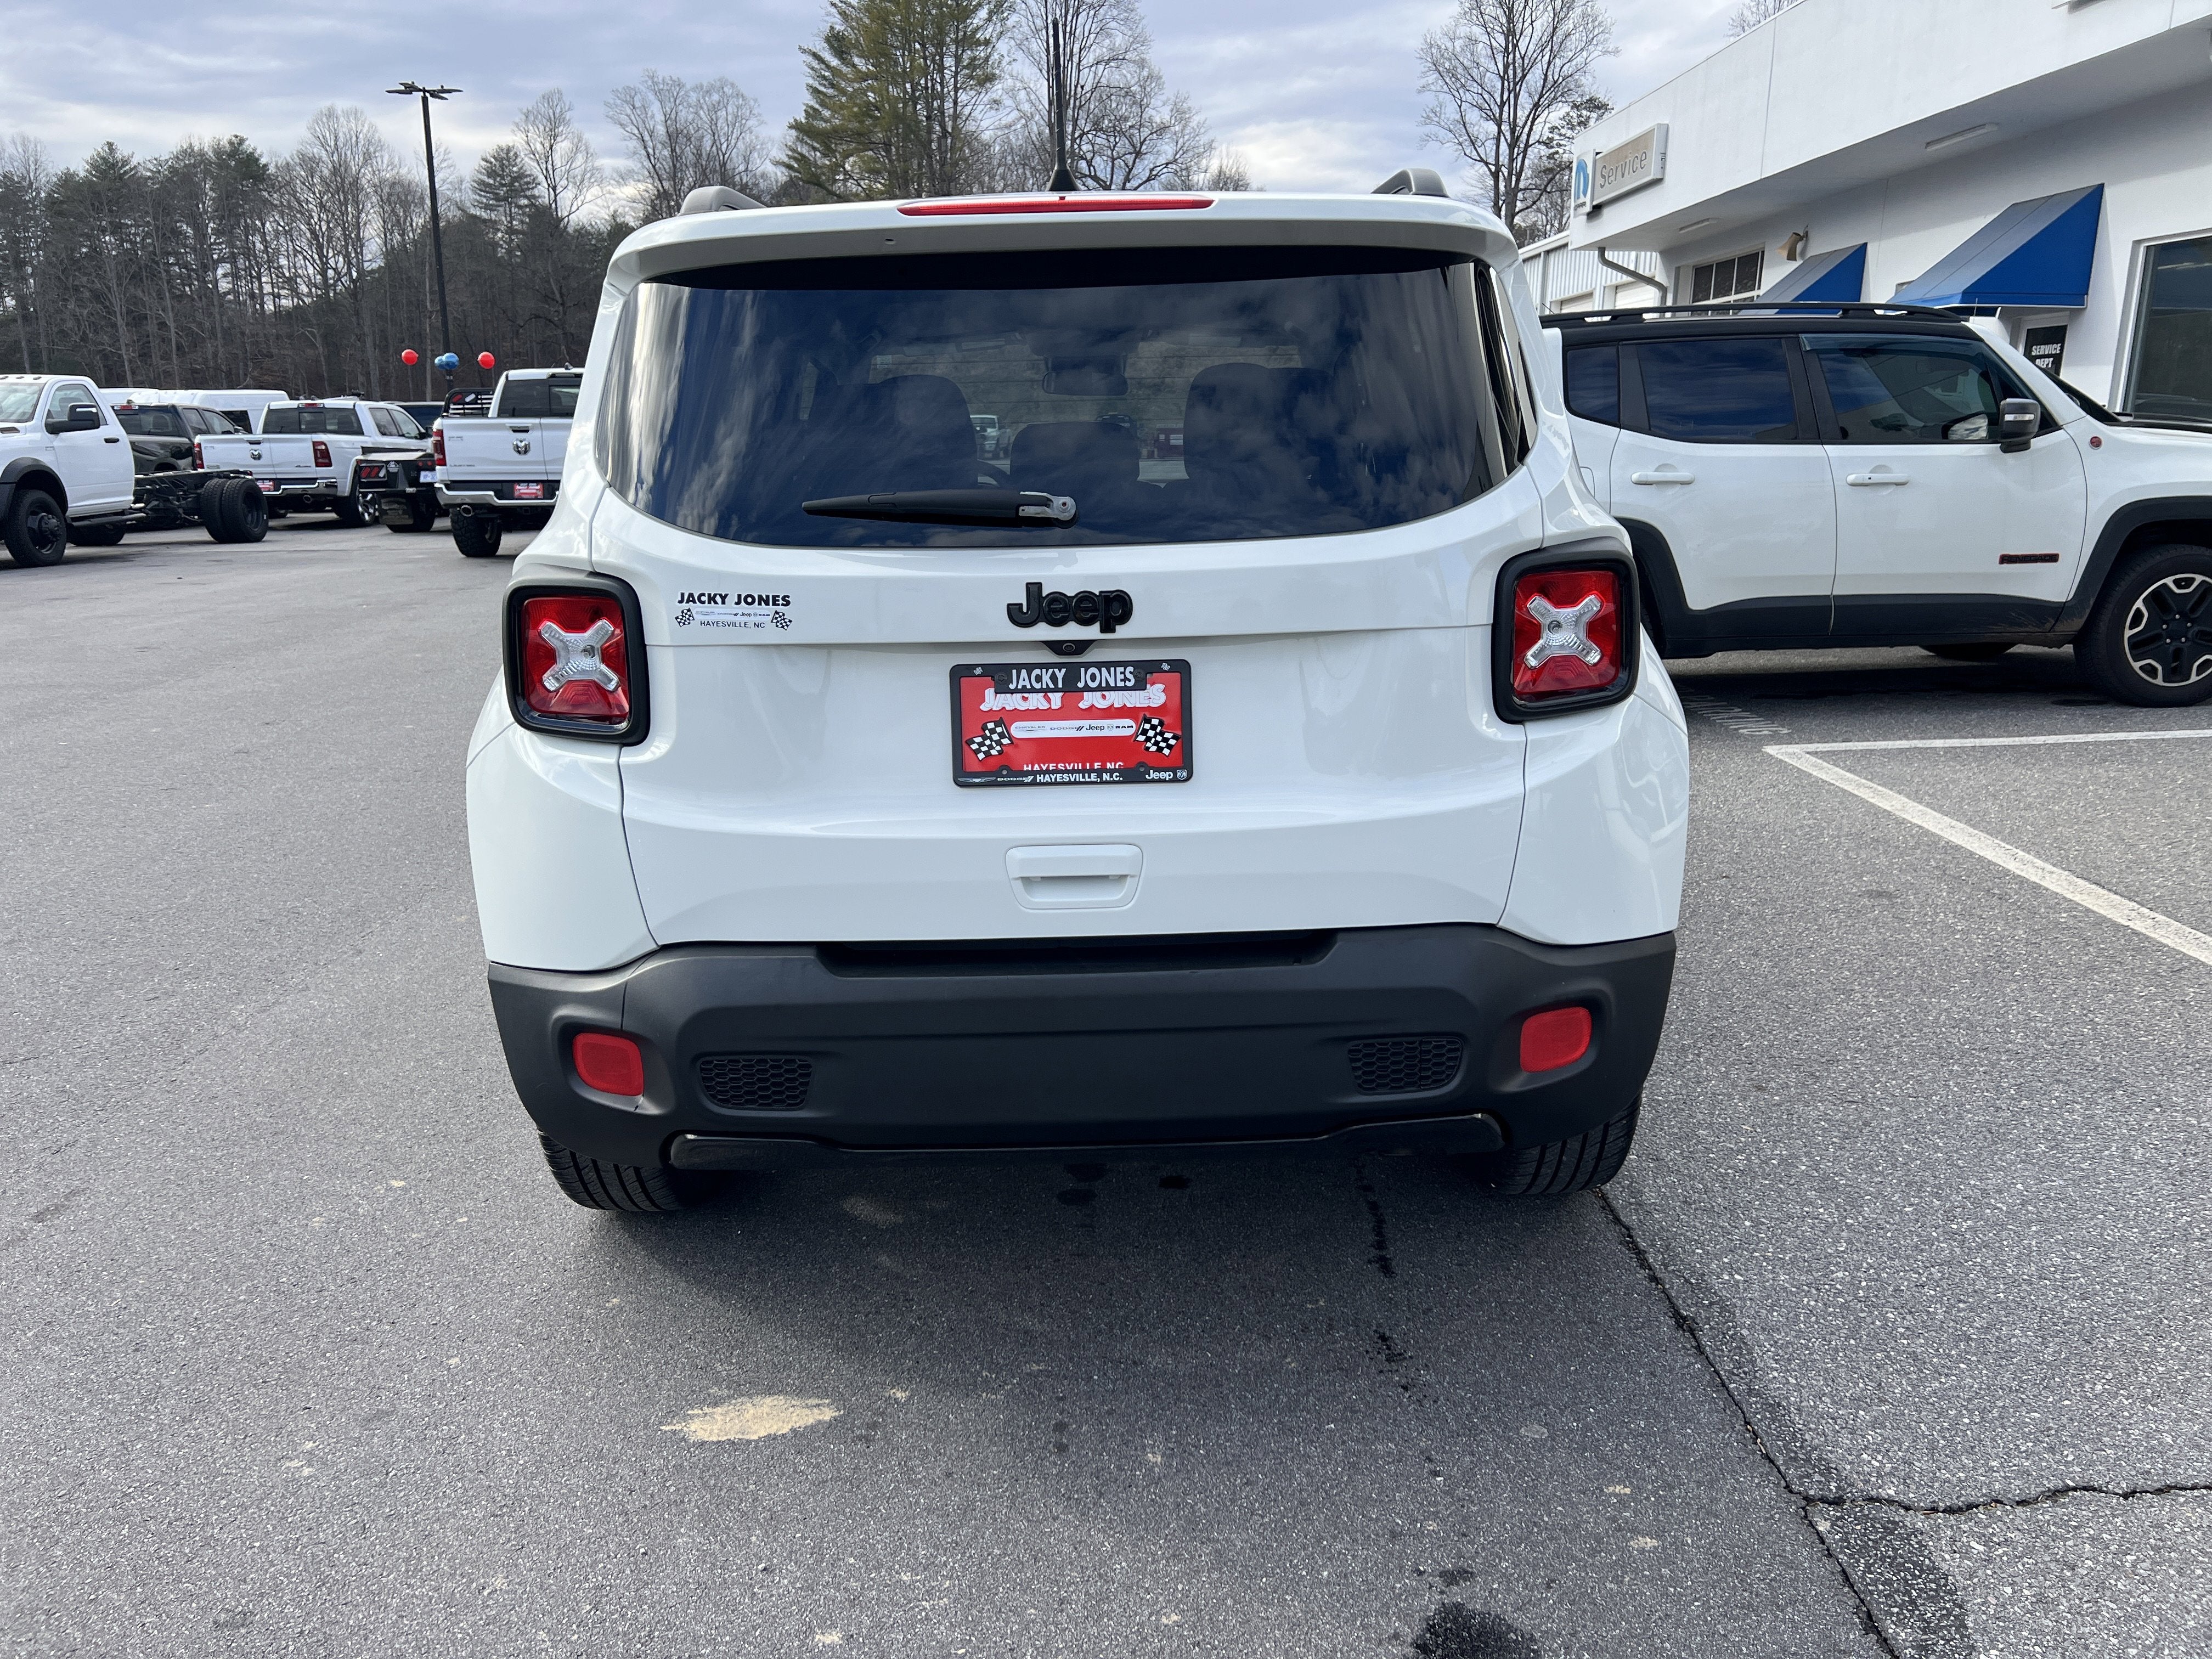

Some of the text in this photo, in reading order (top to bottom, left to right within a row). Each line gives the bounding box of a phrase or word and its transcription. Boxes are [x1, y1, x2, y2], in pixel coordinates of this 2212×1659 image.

[1600, 151, 1647, 189] Service
[2032, 343, 2062, 356] SERVICE
[2035, 358, 2054, 368] DEPT
[678, 592, 791, 606] JACKY JONES
[1007, 582, 1133, 633] Jeep
[700, 620, 751, 629] HAYESVILLE,
[1009, 666, 1135, 690] JACKY JONES
[980, 684, 1166, 711] JACKY JONES
[1036, 773, 1100, 782] HAYESVILLE,
[1103, 772, 1123, 781] N.C.
[1146, 770, 1173, 780] Jeep
